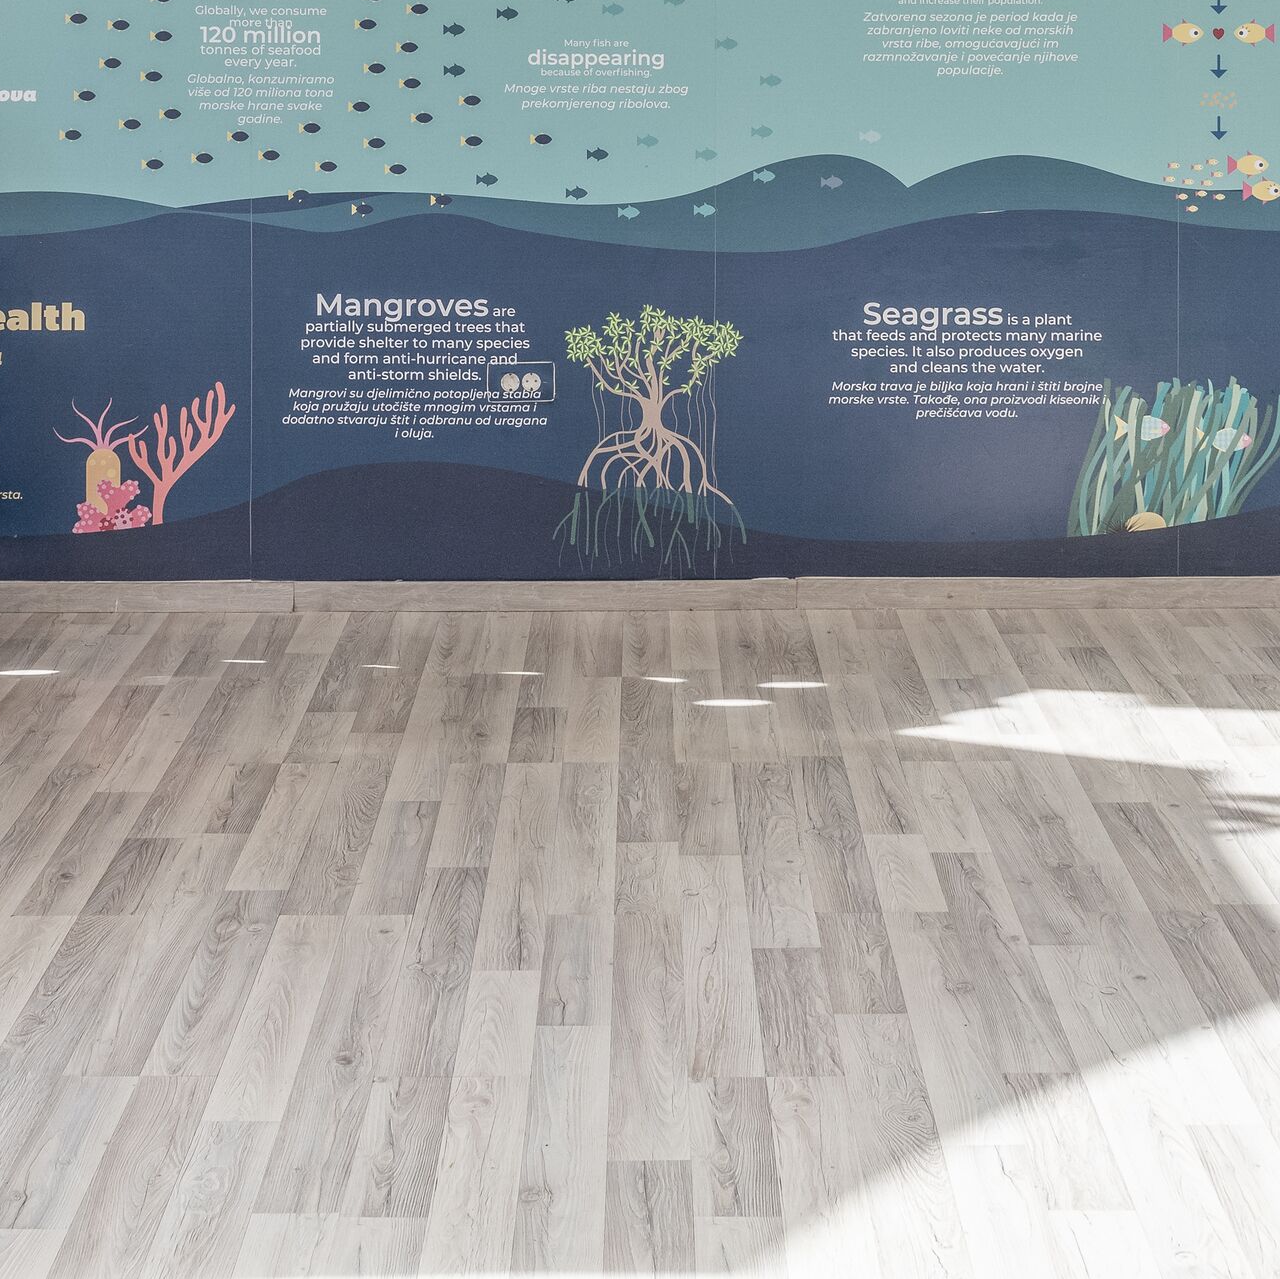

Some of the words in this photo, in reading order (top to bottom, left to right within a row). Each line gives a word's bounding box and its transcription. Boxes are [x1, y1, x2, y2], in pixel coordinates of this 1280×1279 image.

[194, 4, 247, 19] Globally,
[248, 7, 269, 16] we
[270, 7, 328, 17] consume
[198, 24, 237, 44] 120
[243, 24, 322, 45] million
[199, 44, 248, 56] tonnes
[250, 43, 266, 56] of
[267, 43, 322, 56] seafood
[527, 48, 665, 71] disappearing
[582, 67, 594, 77] of
[935, 63, 1004, 78] populacije.
[618, 97, 672, 110] ribolova.
[315, 292, 490, 322] Mangroves
[491, 305, 517, 318] are
[862, 301, 1005, 332] Seagrass
[1006, 312, 1020, 327] is
[1021, 314, 1032, 327] a
[1034, 312, 1073, 329] plant
[347, 367, 425, 381] anti-storm
[427, 367, 482, 382] shields.
[984, 407, 1019, 419] vodu.
